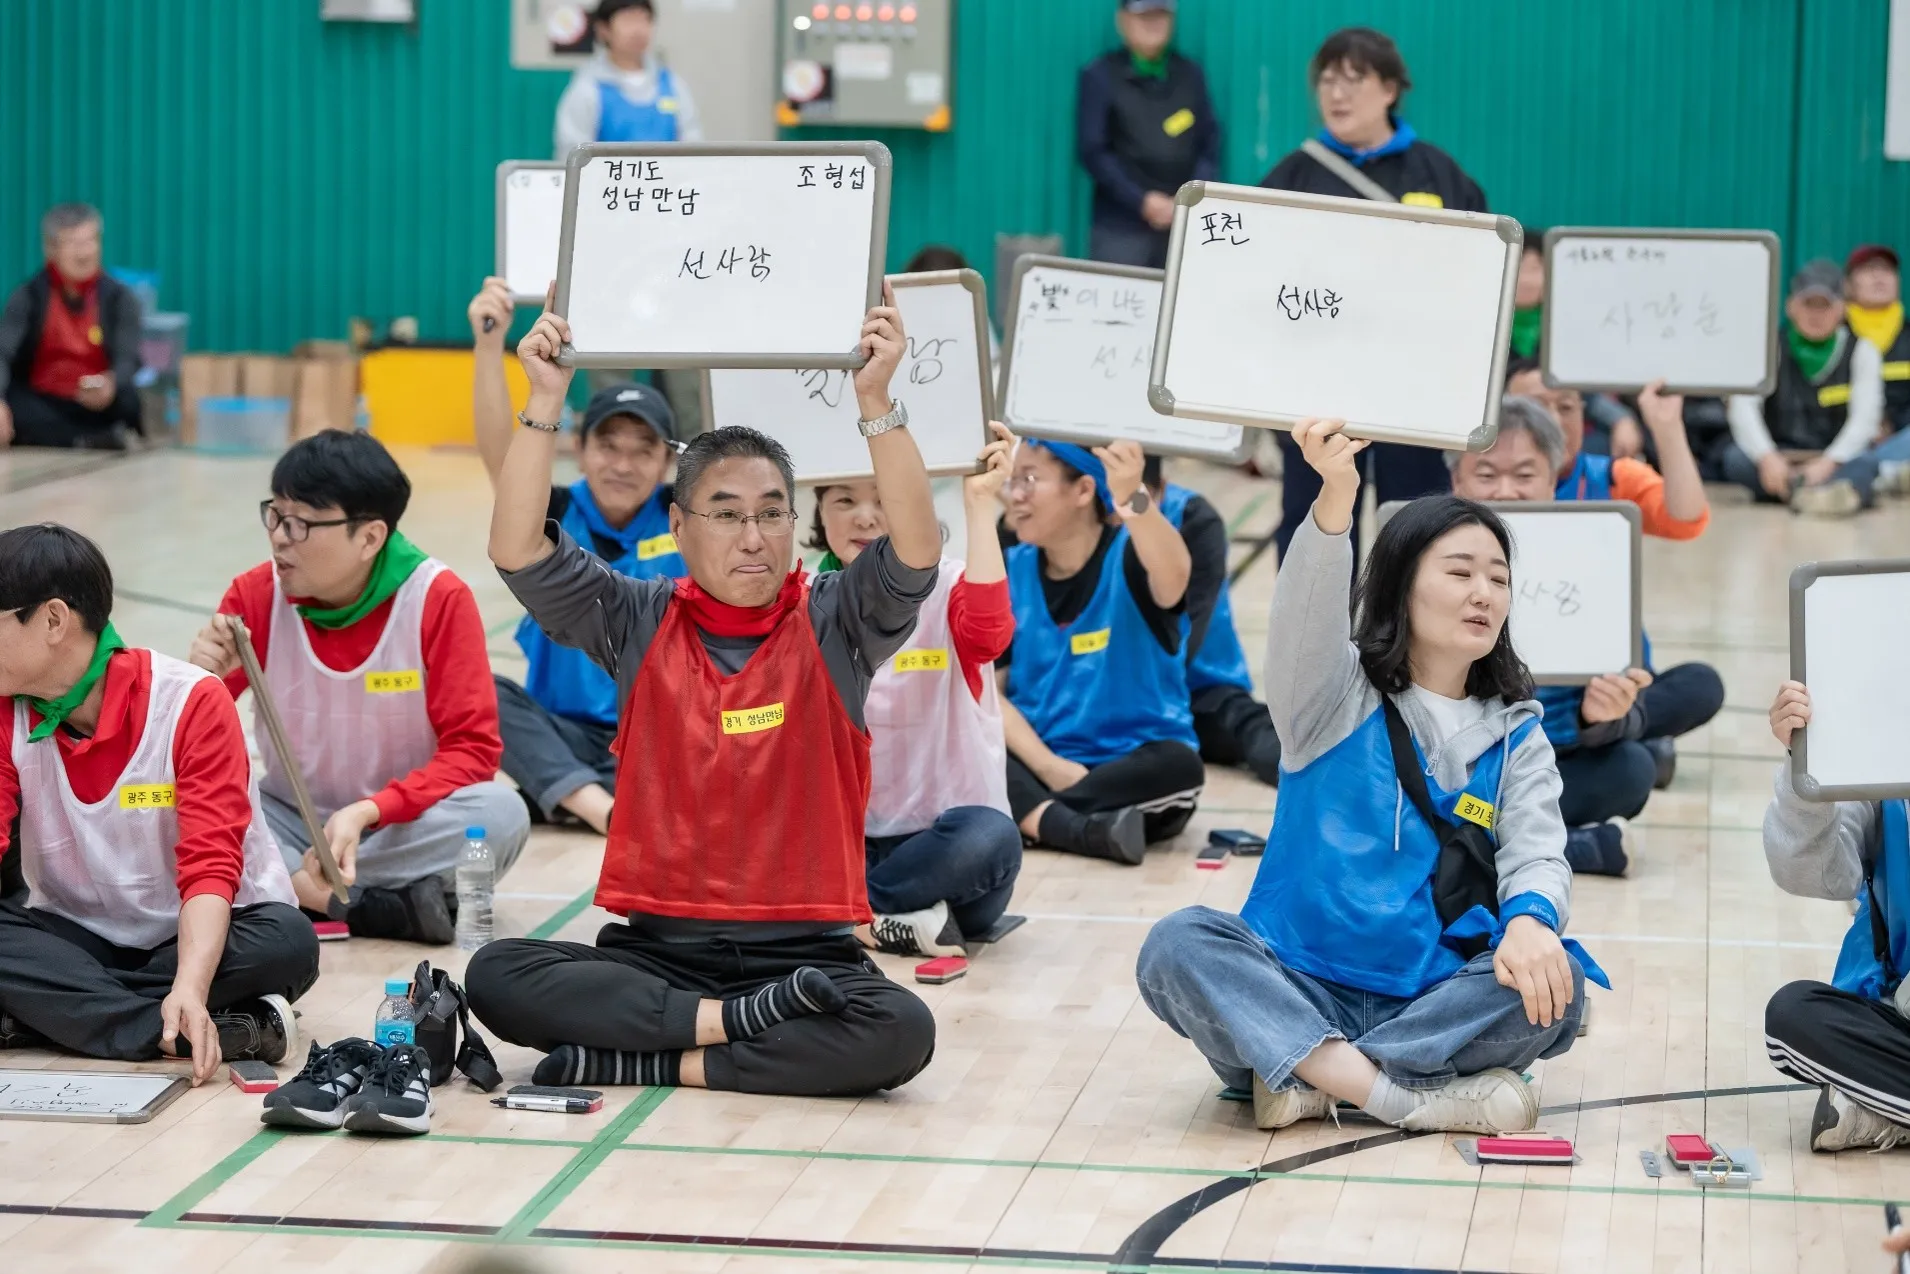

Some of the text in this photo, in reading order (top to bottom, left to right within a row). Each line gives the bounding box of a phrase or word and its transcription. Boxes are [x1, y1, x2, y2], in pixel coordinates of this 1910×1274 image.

[603, 160, 664, 181] 경기도
[796, 162, 866, 190] 조형섭
[1200, 212, 1250, 246] 포천
[678, 245, 772, 283] 선사랑
[1277, 284, 1343, 321] 선사랑
[724, 708, 783, 729] 경기 성남만남
[127, 790, 173, 804] 광주 동구
[1463, 801, 1486, 820] 경기
